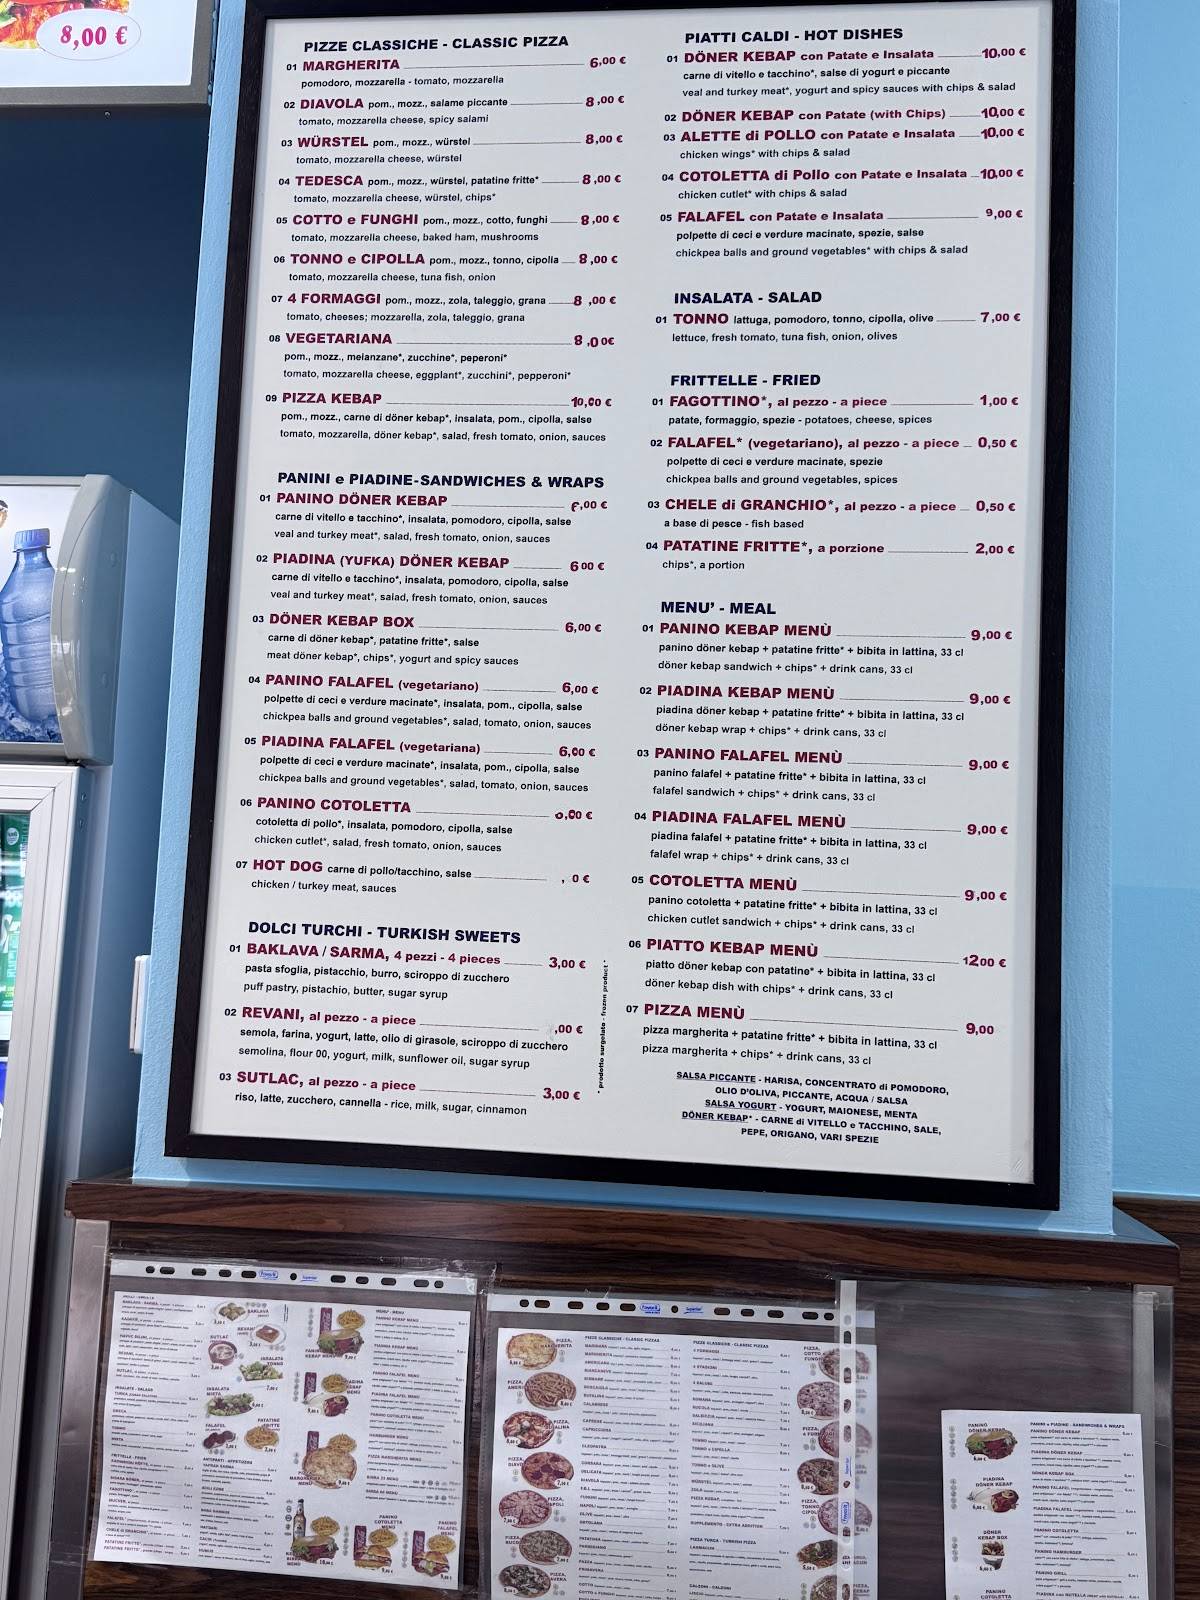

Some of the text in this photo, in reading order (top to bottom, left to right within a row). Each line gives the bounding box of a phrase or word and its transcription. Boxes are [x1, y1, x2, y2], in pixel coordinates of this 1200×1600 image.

[60, 24, 127, 51] 8,00 €
[303, 40, 347, 53] PIZZE
[352, 38, 438, 51] CLASSICHE
[452, 36, 518, 49] CLASSIC
[523, 35, 569, 47] PIZZA
[685, 31, 736, 44] PIATTI
[741, 30, 789, 42] CALDI
[804, 29, 838, 41] HOT
[843, 27, 903, 40] DISHES
[286, 56, 626, 71] 01 MARGHERITA 6,00 €
[283, 95, 625, 110] 02 DIAVOLA pom., mozz., salame piccante 8,00 €
[281, 133, 623, 148] 03 WÜRSTEL pom., mozz., würstel 8,00 €
[660, 213, 672, 222] 05
[677, 210, 745, 222] FALAFEL
[749, 214, 772, 222] con
[776, 211, 817, 221] Patate
[832, 210, 883, 220] Insalata
[985, 208, 1012, 220] 9,00
[1015, 209, 1023, 218] €
[674, 292, 753, 304] INSALATA
[767, 291, 822, 303] SALAD
[655, 311, 1021, 326] 01 TONNO lattuga, pomodoro, tonno, cipolla, olive 7,00 €
[670, 374, 758, 386] FRITTELLE
[772, 374, 821, 386] FRIED
[277, 472, 330, 484] PANINI
[335, 475, 345, 485] e
[530, 476, 542, 488] &
[547, 476, 604, 488] WRAPS
[645, 542, 658, 550] 04
[663, 539, 739, 552] PATATINE
[829, 543, 884, 555] porzione
[975, 542, 1004, 556] 2,00
[1007, 545, 1015, 554] €
[708, 560, 745, 571] portion
[729, 602, 776, 615] MEAL
[252, 611, 602, 633] 03 DÖNER KEBAP BOX 6,00 €
[642, 622, 1012, 641] 01 PANINO KEBAP MENÙ 9,00 €
[248, 921, 296, 935] DOLCI
[301, 923, 362, 937] TURCHI
[376, 926, 450, 941] TURKISH
[454, 929, 521, 944] SWEETS
[243, 981, 448, 1001] puff pastry, pistachio, butter, sugar syrup
[599, 1022, 607, 1056] surgelato
[219, 1072, 232, 1081] 03
[236, 1071, 303, 1088] SUTLAC,
[308, 1076, 320, 1086] al
[323, 1079, 359, 1089] pezzo
[370, 1081, 378, 1089] a
[381, 1079, 416, 1092] piece
[542, 1087, 569, 1101] 3,00
[572, 1091, 580, 1100] €
[704, 1098, 736, 1109] SALSA
[738, 1100, 777, 1112] YOGURT
[784, 1103, 826, 1115] YOGURT,
[828, 1106, 882, 1118] MAIONESE,
[884, 1110, 918, 1119] MENTA
[741, 1127, 879, 1144] PEPE, ORIGANO, VARI SPEZIE
